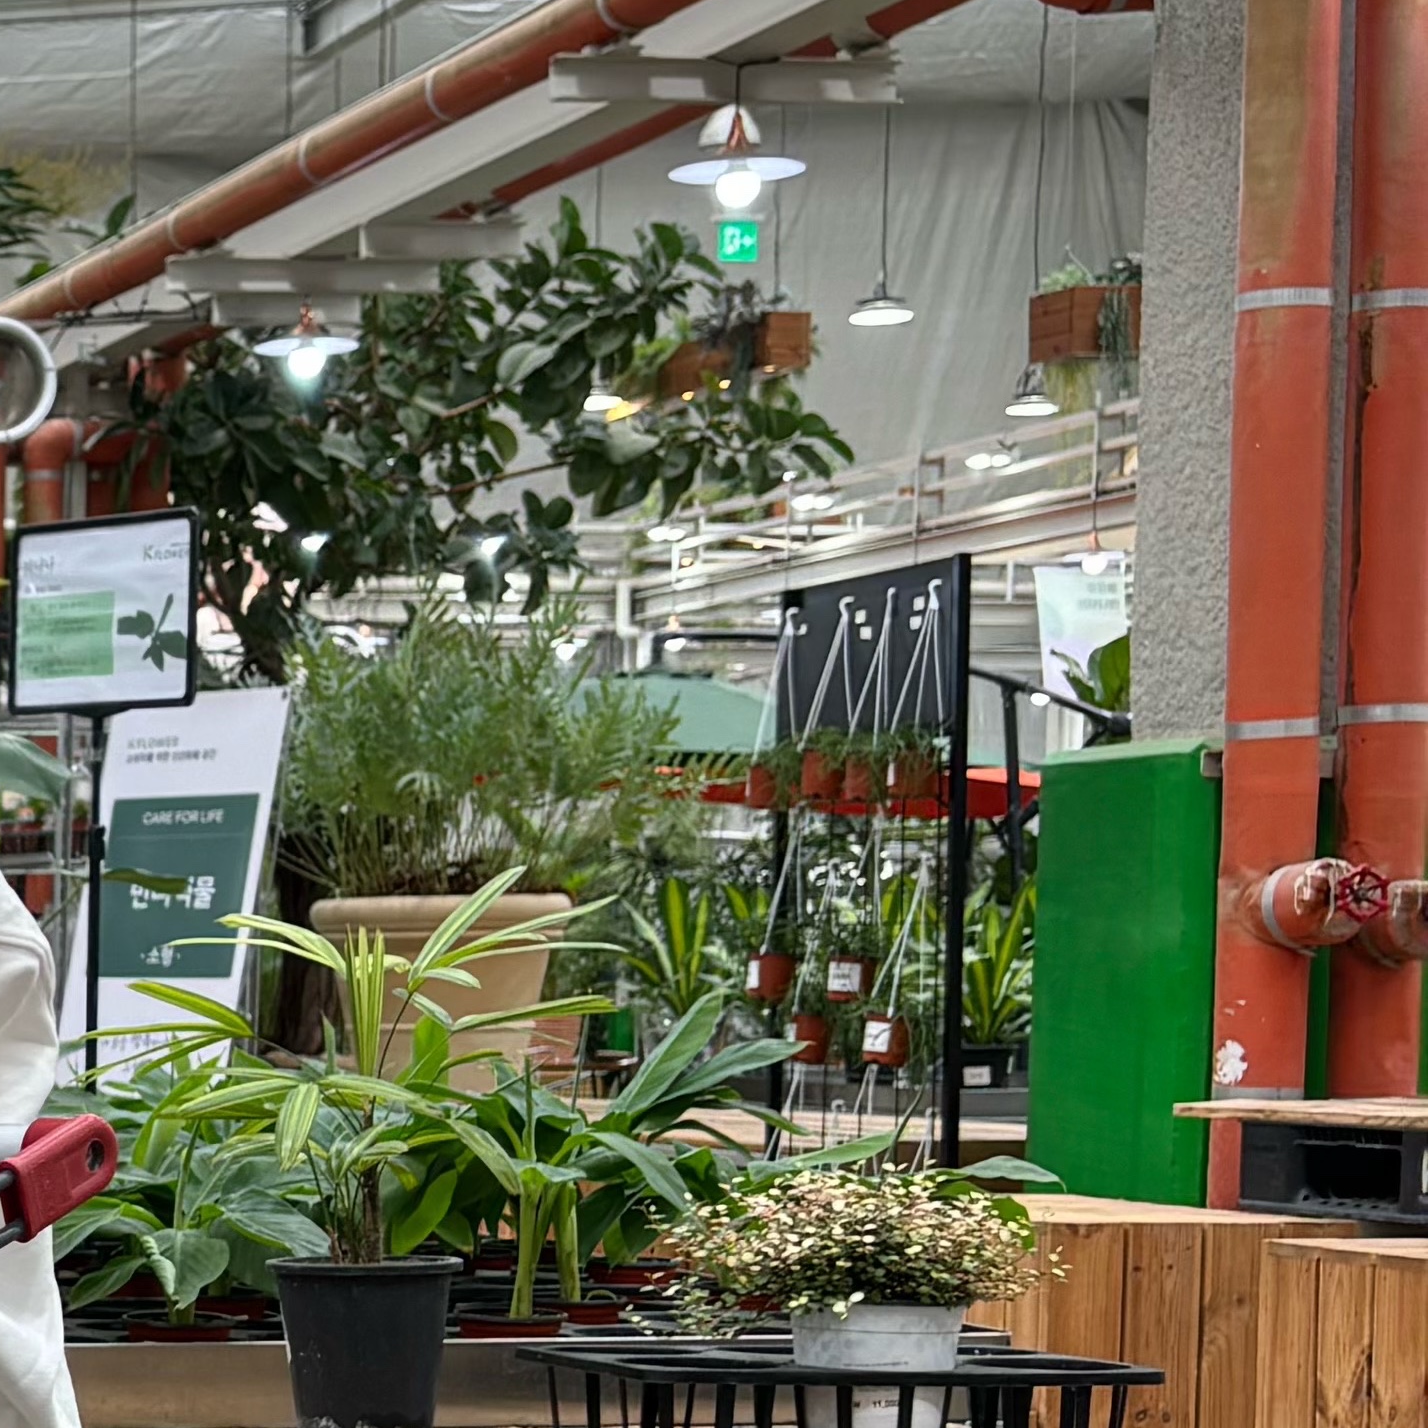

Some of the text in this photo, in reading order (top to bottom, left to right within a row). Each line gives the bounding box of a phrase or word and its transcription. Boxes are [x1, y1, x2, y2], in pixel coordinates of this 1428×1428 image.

[143, 807, 224, 825] CARE FOR LIFE
